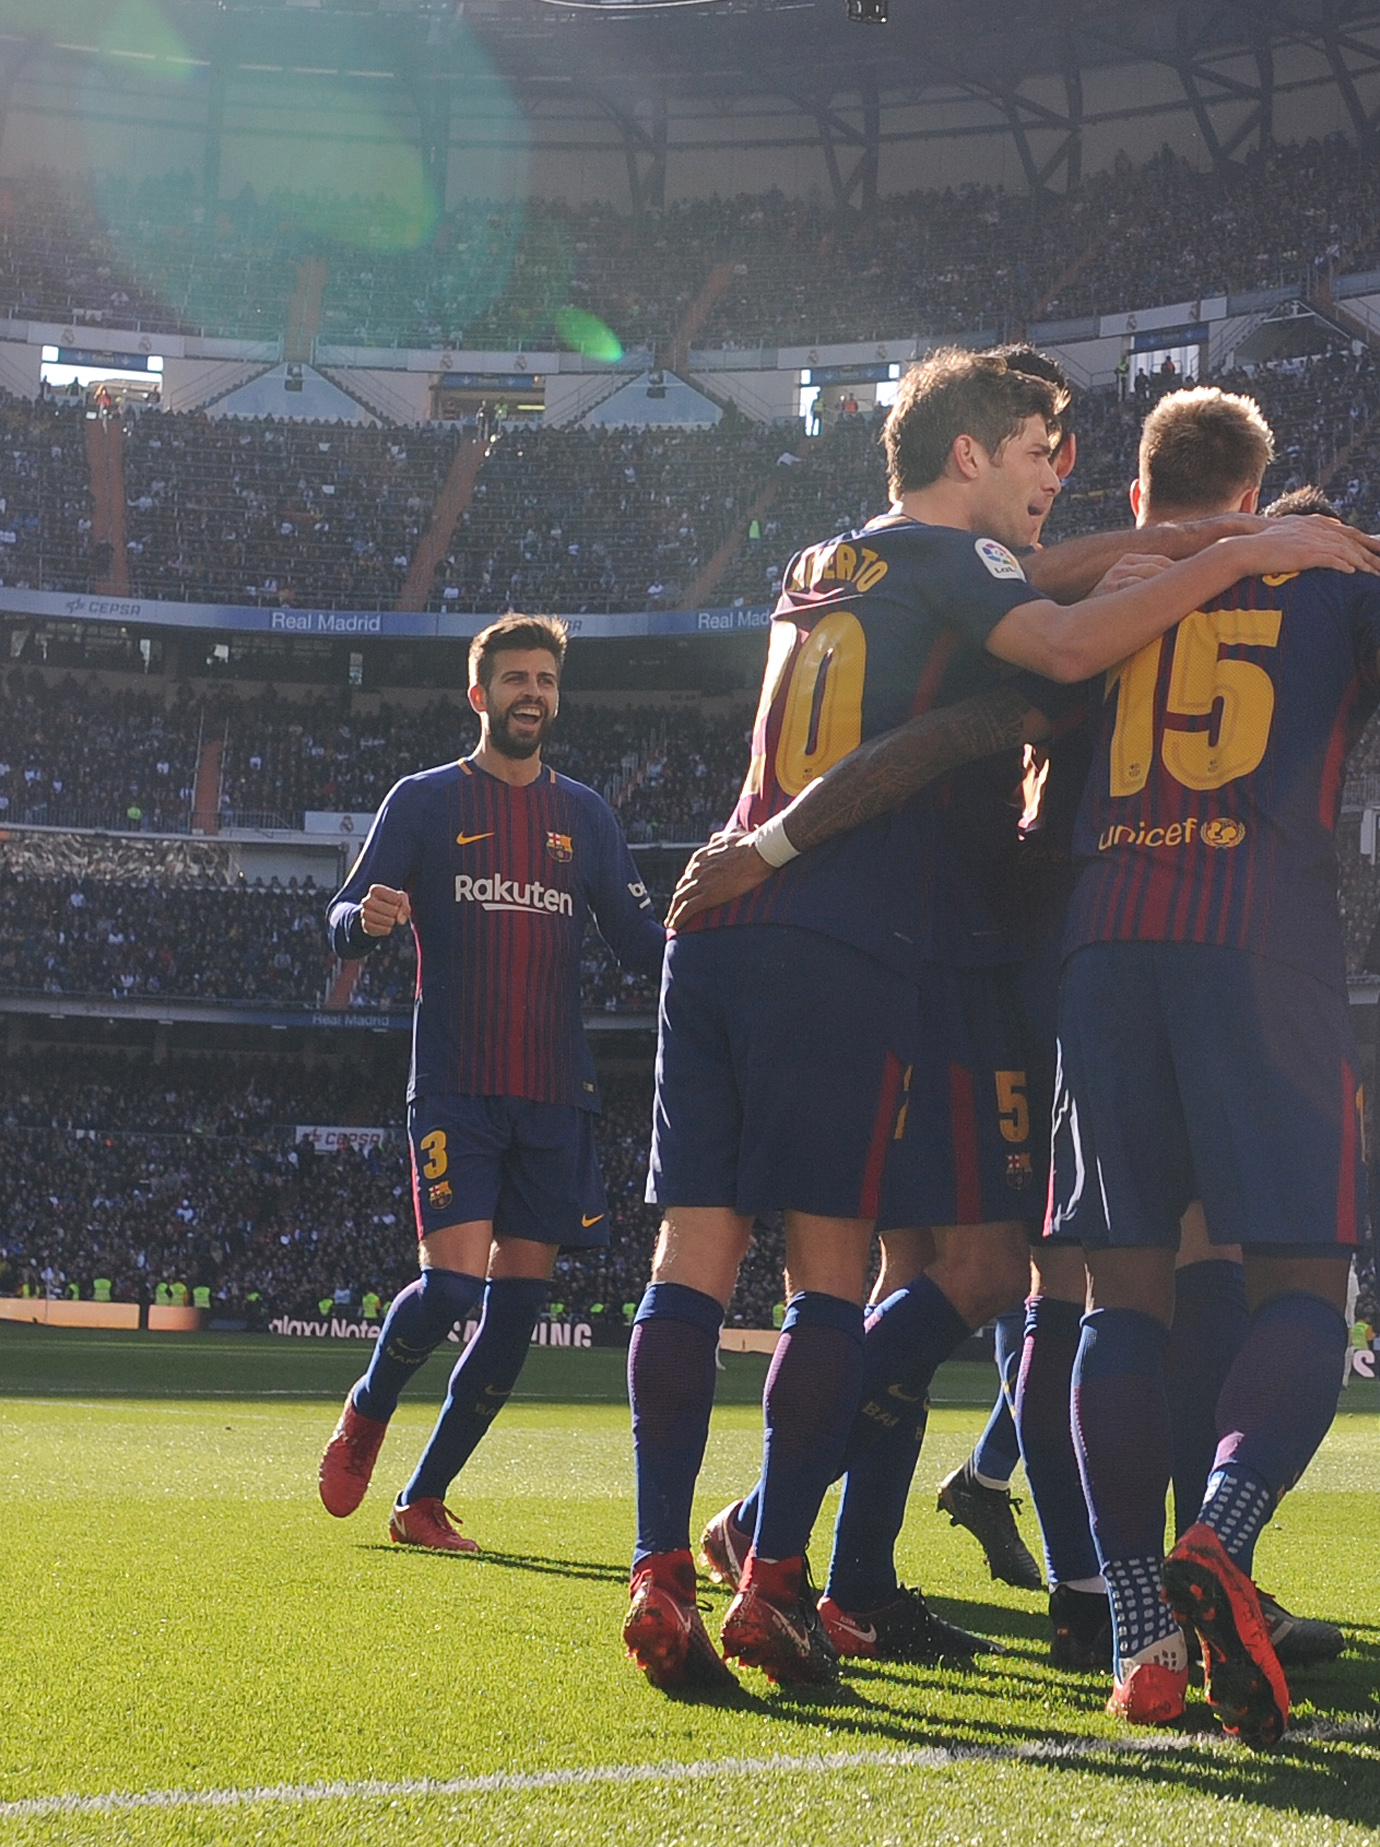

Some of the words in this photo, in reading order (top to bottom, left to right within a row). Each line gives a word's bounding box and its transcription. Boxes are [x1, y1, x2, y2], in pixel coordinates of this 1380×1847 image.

[88, 601, 141, 616] CEPSA
[272, 612, 312, 630] Real
[318, 614, 381, 632] Madrid
[698, 612, 734, 630] Real
[737, 609, 771, 628] Mad
[1103, 610, 1283, 797] 15
[1098, 818, 1197, 851] unicef
[455, 873, 573, 917] Rakuten
[313, 1013, 341, 1025] Real
[344, 1014, 389, 1026] Madrid
[995, 1071, 1029, 1143] 5
[420, 1130, 448, 1179] 3
[268, 1314, 329, 1336] alaxy
[330, 1317, 380, 1339] Note
